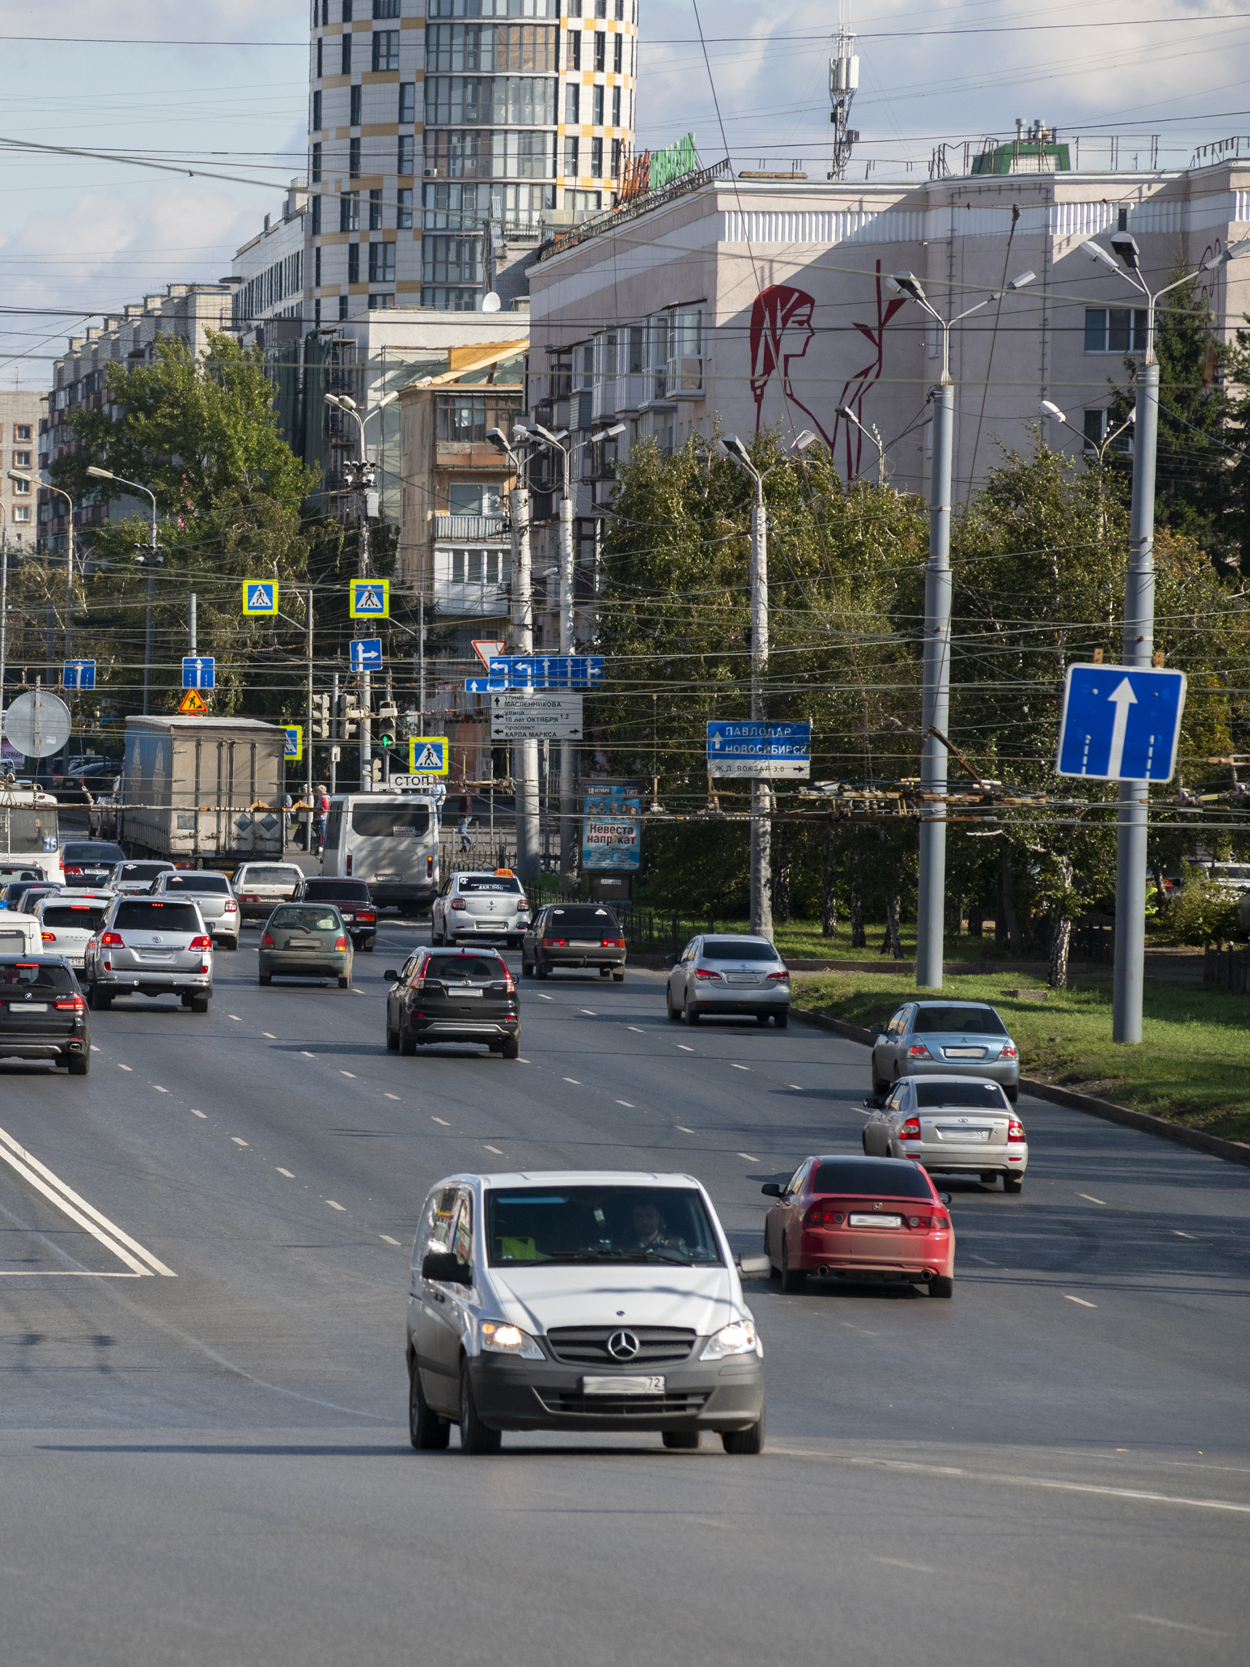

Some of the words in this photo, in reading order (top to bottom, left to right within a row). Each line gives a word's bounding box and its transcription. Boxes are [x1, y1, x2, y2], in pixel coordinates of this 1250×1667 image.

[725, 726, 792, 737] ПАВЛОДАР
[725, 744, 807, 755] НОВОСИБИРСК
[394, 776, 429, 786] СТОП
[589, 823, 634, 835] Невеста
[44, 838, 58, 851] 16
[647, 1377, 661, 1388] 72
